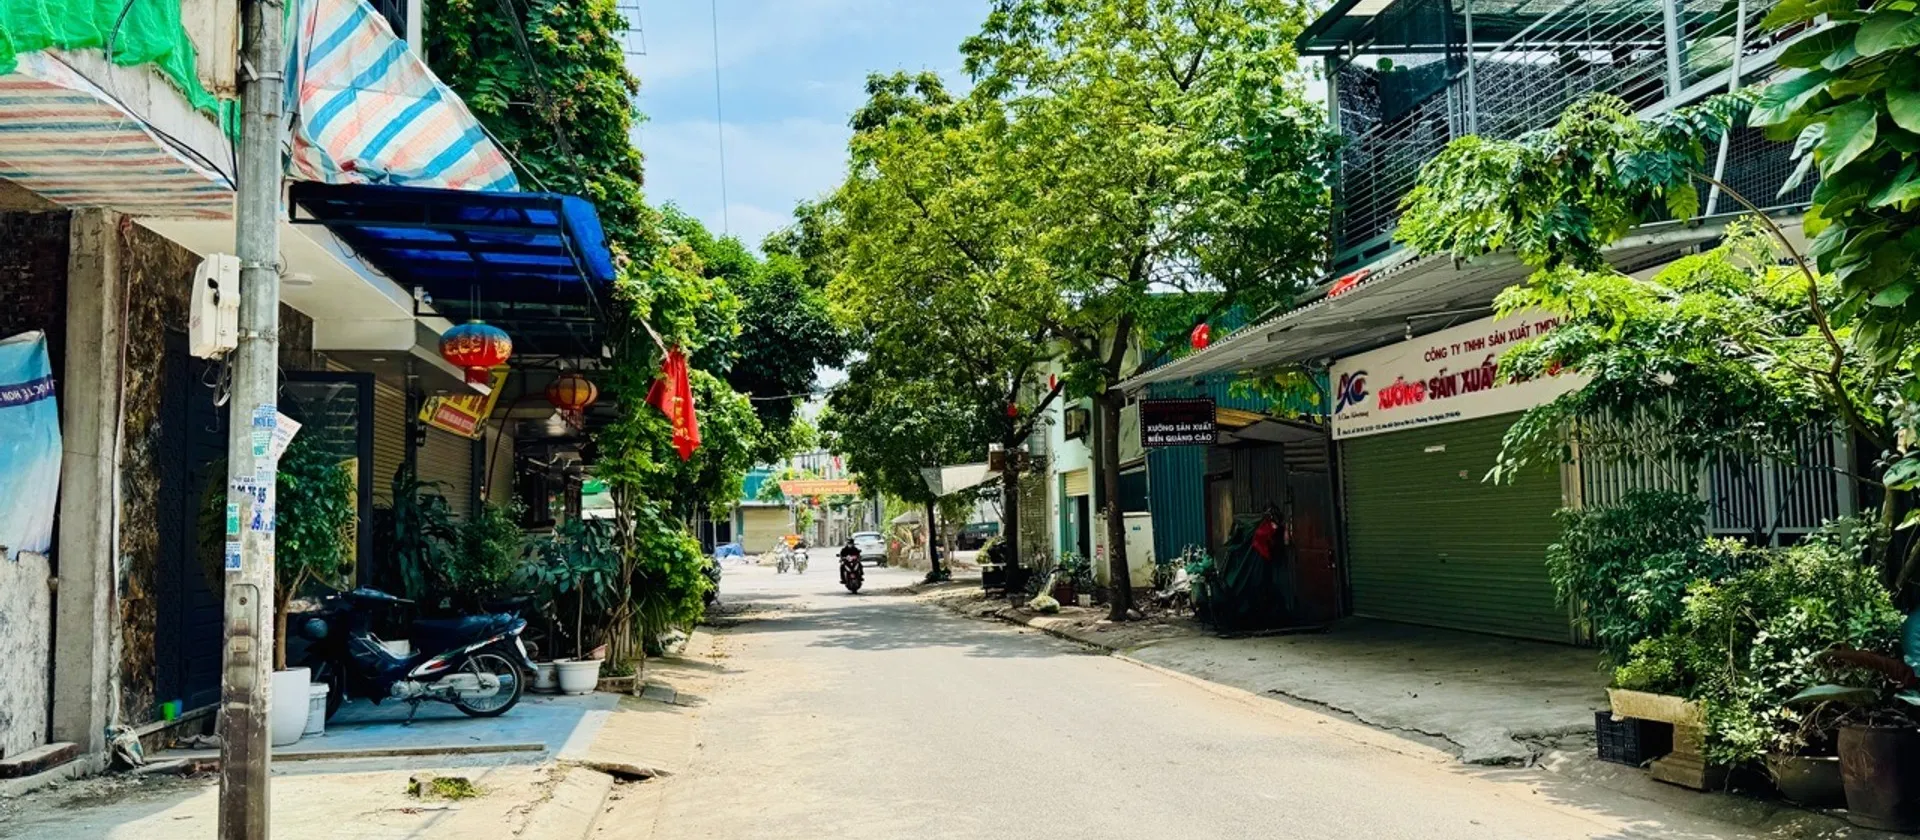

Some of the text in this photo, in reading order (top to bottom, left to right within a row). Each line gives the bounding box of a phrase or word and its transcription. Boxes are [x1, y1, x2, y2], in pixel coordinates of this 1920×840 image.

[1424, 346, 1447, 362] CÔNG
[1450, 343, 1461, 356] TY
[1463, 337, 1485, 352] TNHH
[1488, 329, 1506, 347] SẢN
[1508, 320, 1531, 342] XUẤT
[1378, 376, 1427, 410] XƯỞNG
[1429, 368, 1458, 400] SẢN
[1147, 421, 1212, 432] XƯỞNG SẢN XUẤT
[1165, 432, 1193, 442] QUẢNG
[1194, 432, 1212, 441] CÁO
